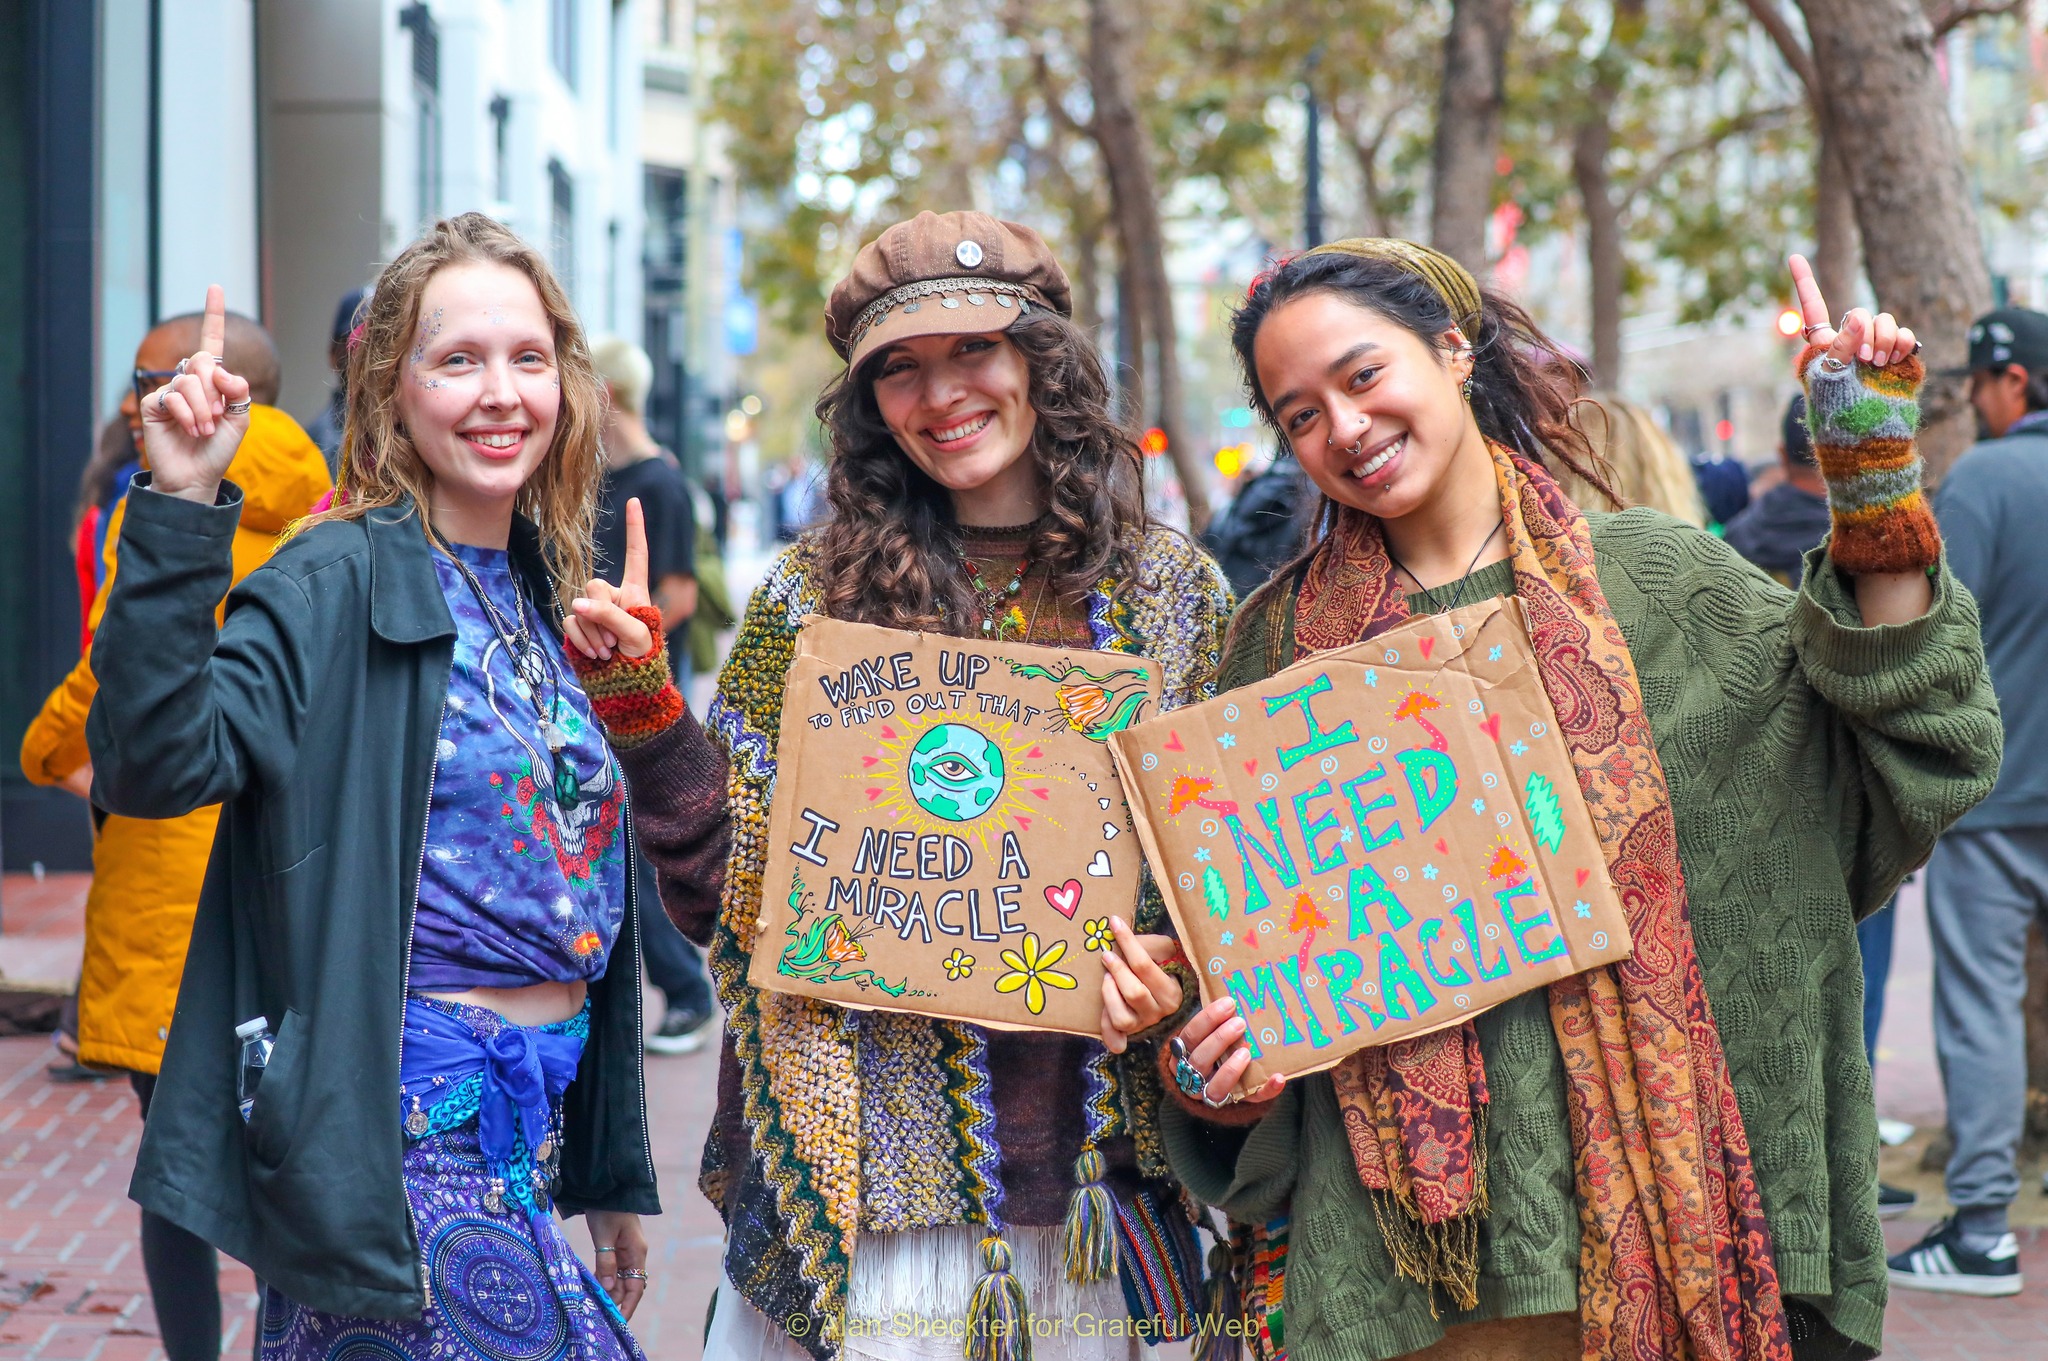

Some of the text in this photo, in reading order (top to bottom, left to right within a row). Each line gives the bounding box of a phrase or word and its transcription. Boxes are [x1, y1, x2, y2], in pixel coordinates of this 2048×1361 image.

[808, 713, 832, 730] TO
[907, 691, 967, 714] OUT
[977, 692, 1041, 727] THAT
[818, 650, 990, 708] WAKE UP
[1261, 672, 1359, 772] I
[789, 807, 1030, 881] I NEED A
[1222, 746, 1459, 915] NEED
[1348, 862, 1414, 941] A
